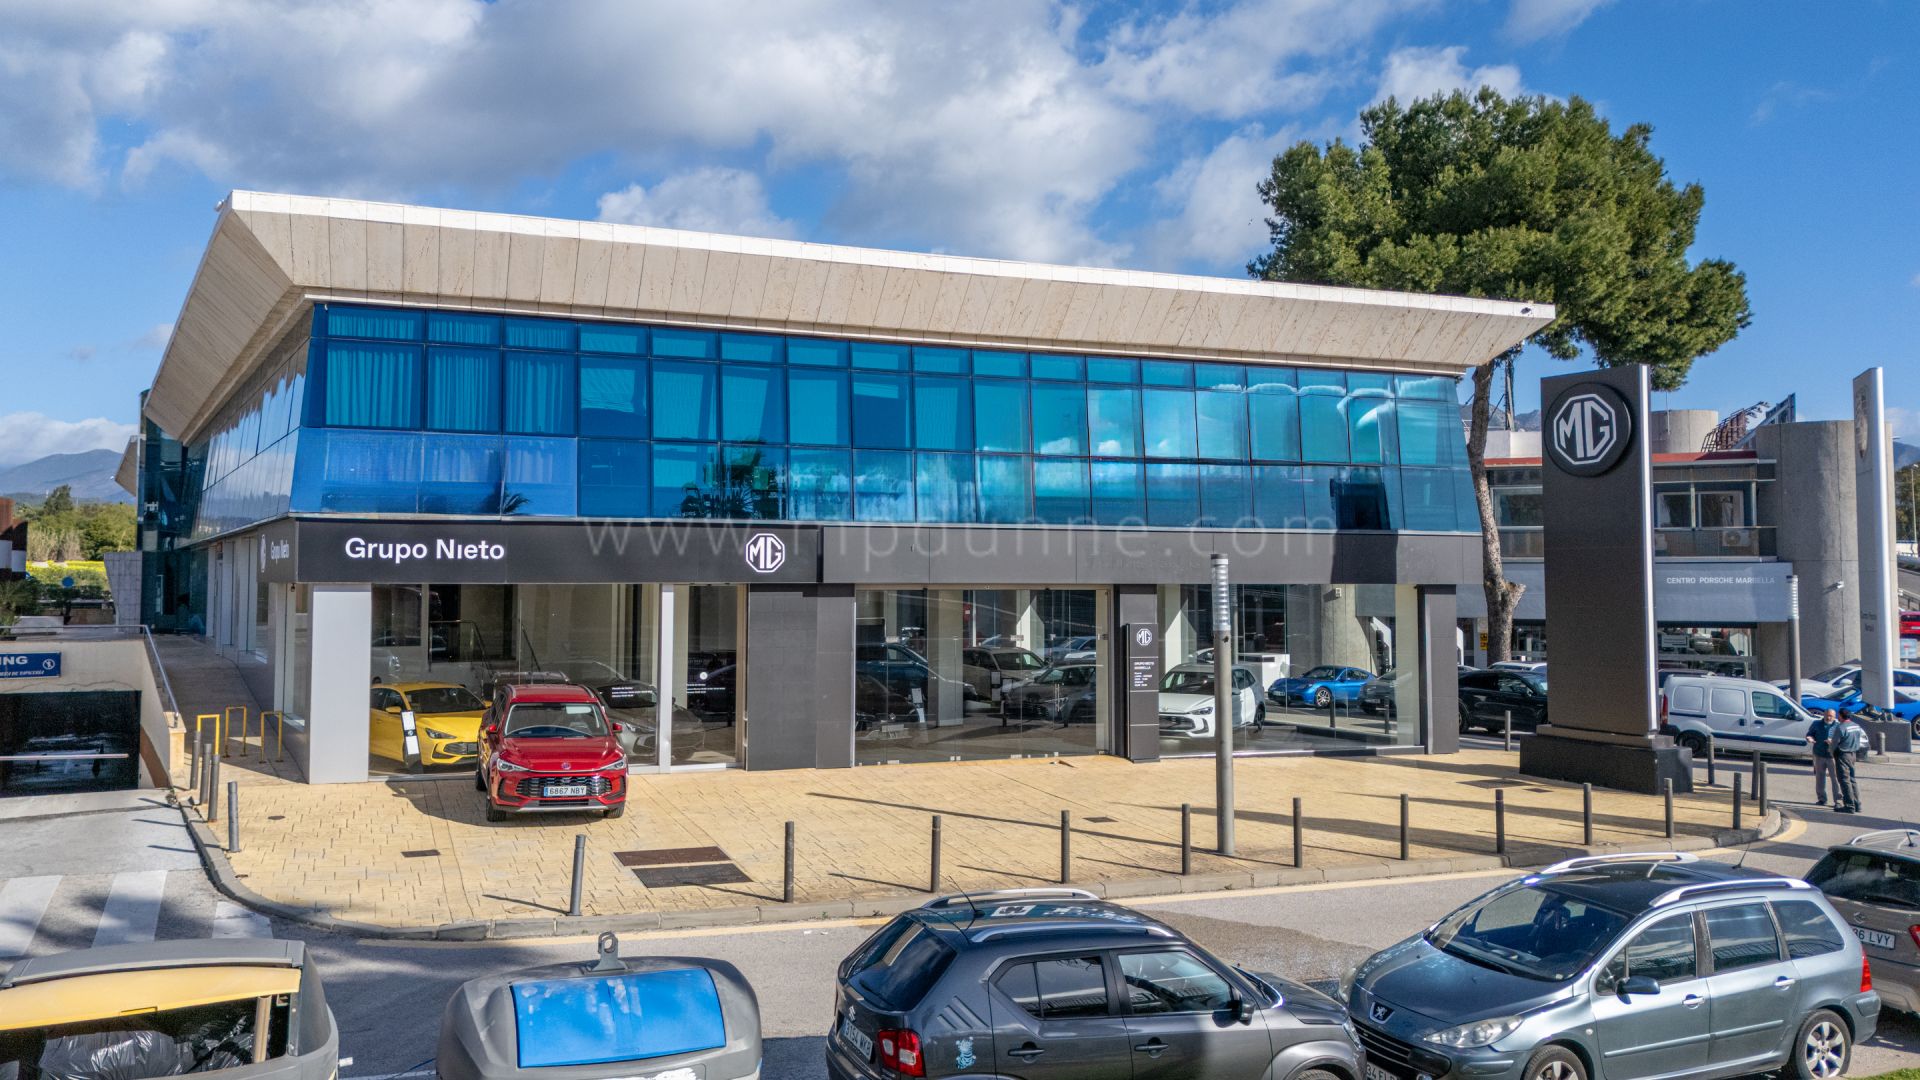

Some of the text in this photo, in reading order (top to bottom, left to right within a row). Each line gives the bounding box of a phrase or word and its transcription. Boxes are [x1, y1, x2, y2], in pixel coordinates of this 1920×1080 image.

[1556, 396, 1615, 463] MG
[345, 537, 505, 564] Grupo Nieto
[747, 534, 784, 572] MG
[1869, 932, 1890, 945] LVY
